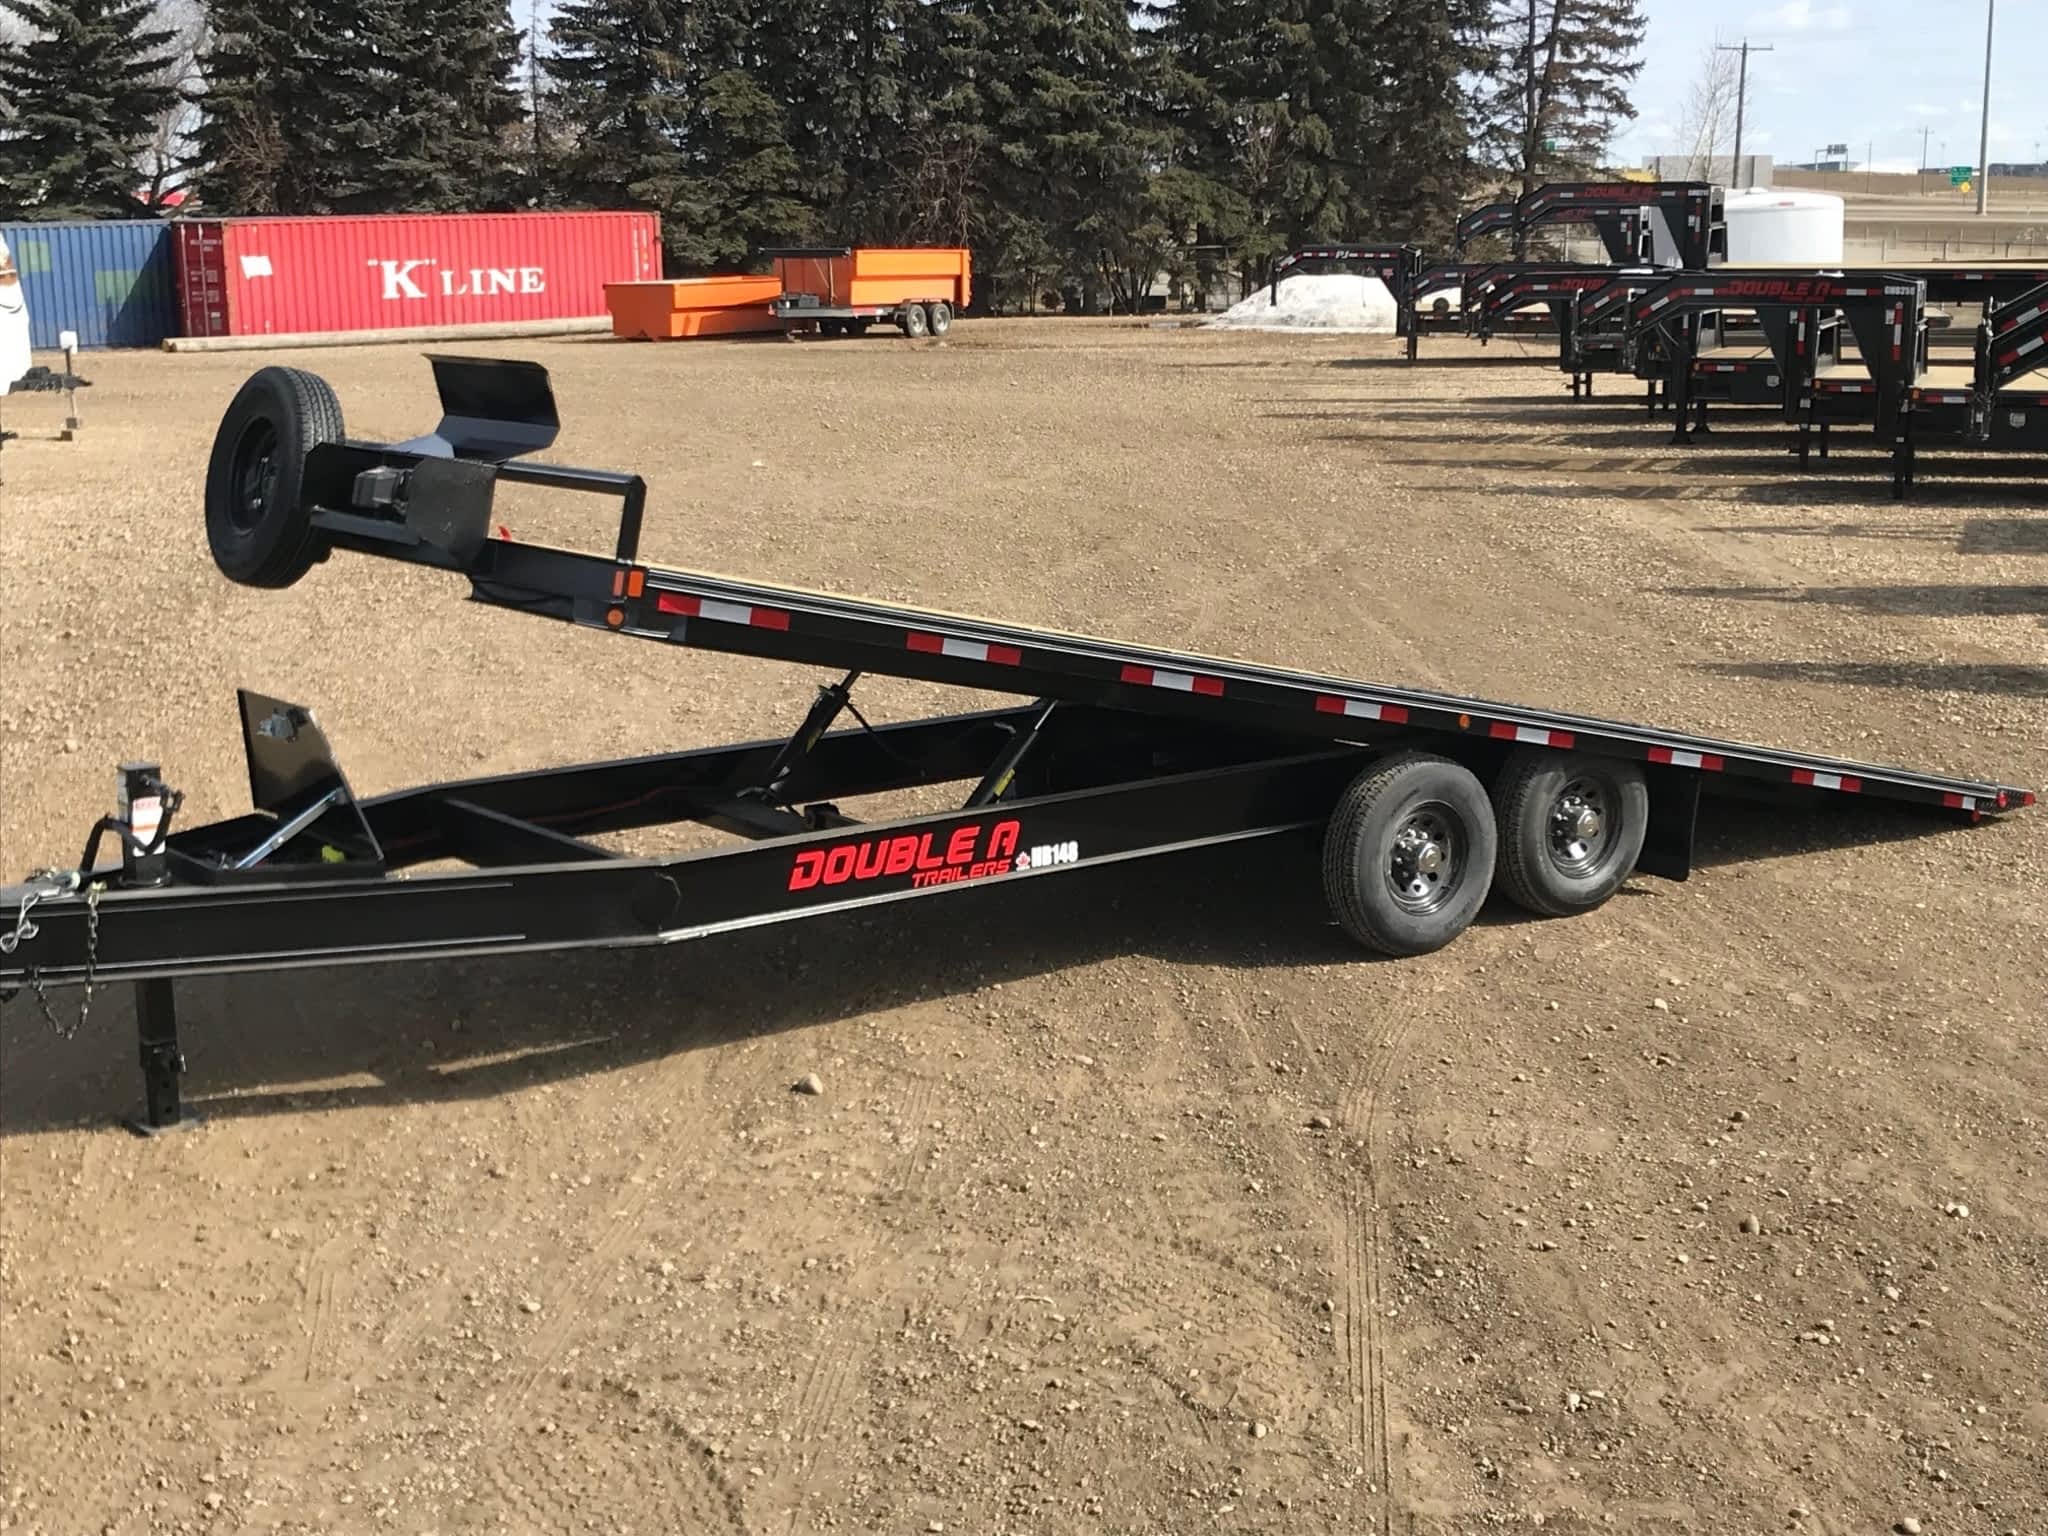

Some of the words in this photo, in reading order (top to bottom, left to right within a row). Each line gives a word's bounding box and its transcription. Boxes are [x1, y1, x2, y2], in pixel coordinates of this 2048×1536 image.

[1335, 250, 1349, 259] PJ
[440, 267, 546, 296] LINE
[1727, 280, 1810, 296] DOUBLE
[788, 825, 981, 892] DOUBLE
[986, 819, 1020, 859] A
[912, 858, 1012, 889] TRAILERS
